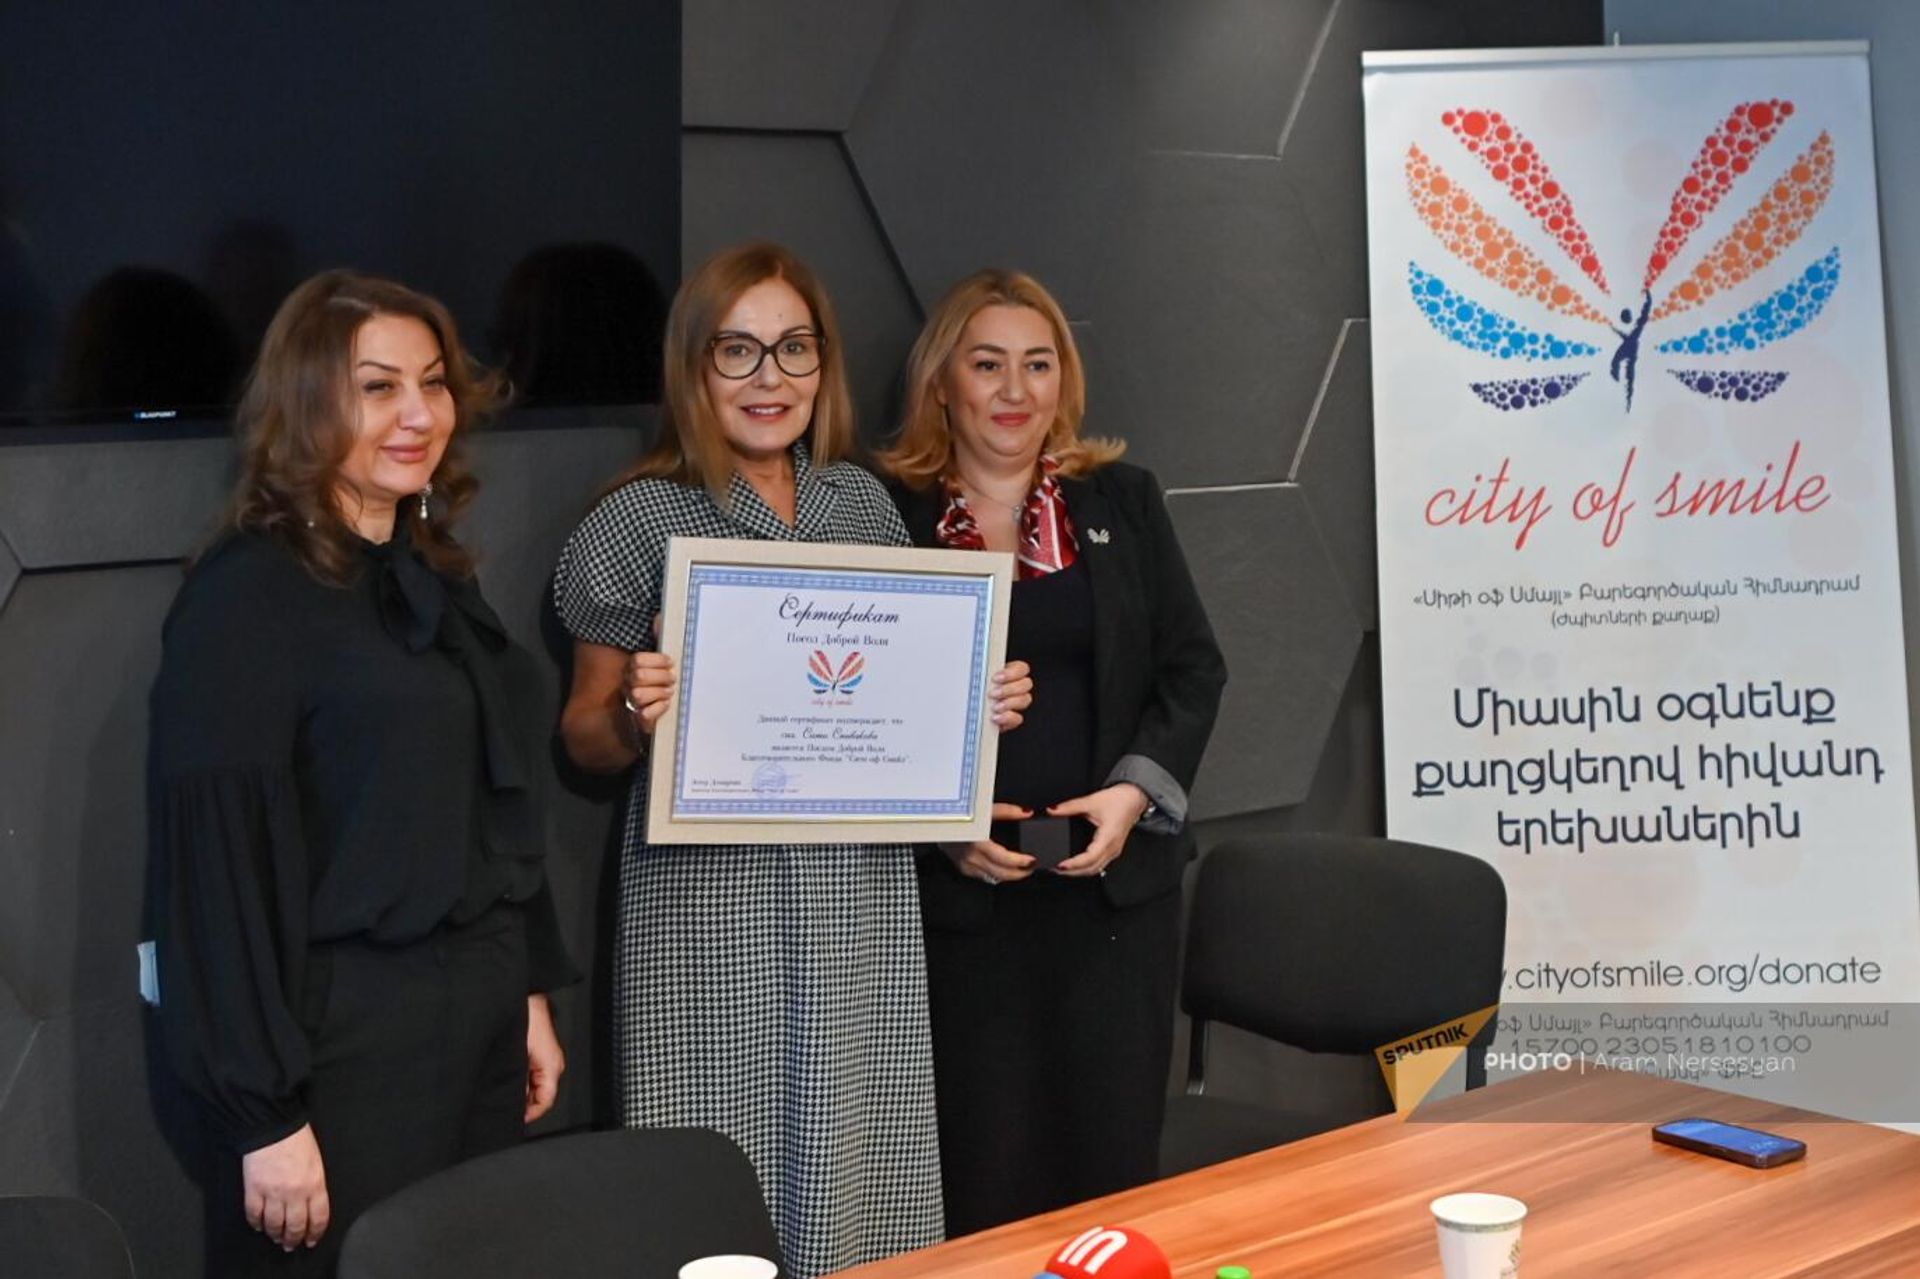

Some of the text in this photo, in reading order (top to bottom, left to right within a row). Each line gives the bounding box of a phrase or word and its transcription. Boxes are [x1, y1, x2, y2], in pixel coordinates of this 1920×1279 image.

[1424, 440, 1831, 551] city of smile
[778, 592, 900, 630] Сертификат
[1454, 681, 1836, 736] Միասին օգնենք
[1412, 740, 1885, 798] քաղցկեղով հիվանդ
[1497, 802, 1801, 855] երեխաներին
[1501, 952, 1882, 995] .cityofsmile.org/donate
